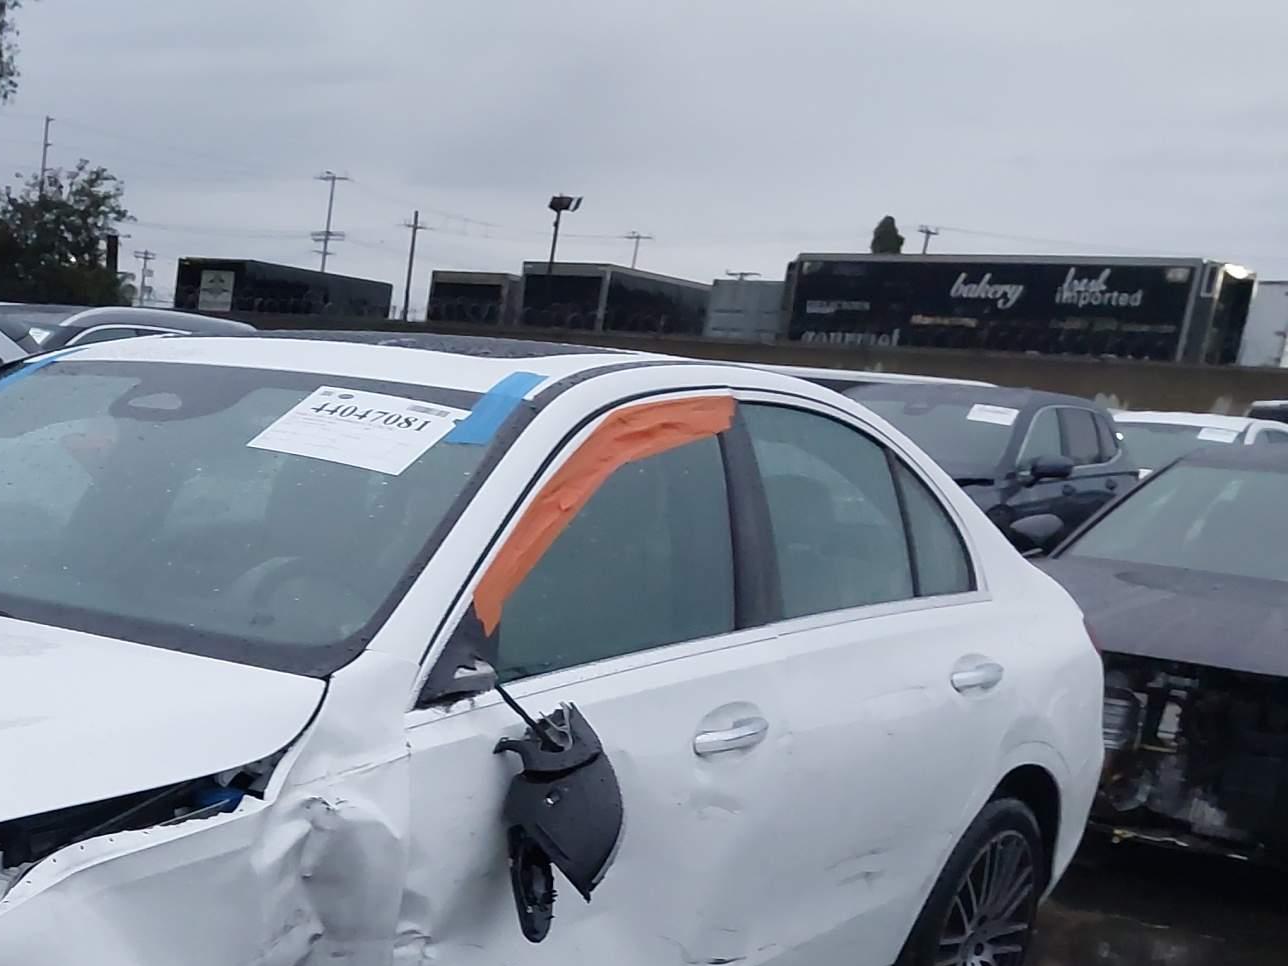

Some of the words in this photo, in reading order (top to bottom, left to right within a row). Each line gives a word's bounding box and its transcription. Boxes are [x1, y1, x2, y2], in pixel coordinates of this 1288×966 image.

[950, 272, 1024, 309] bakery
[1055, 286, 1143, 308] imported
[310, 402, 431, 432] 44047081
